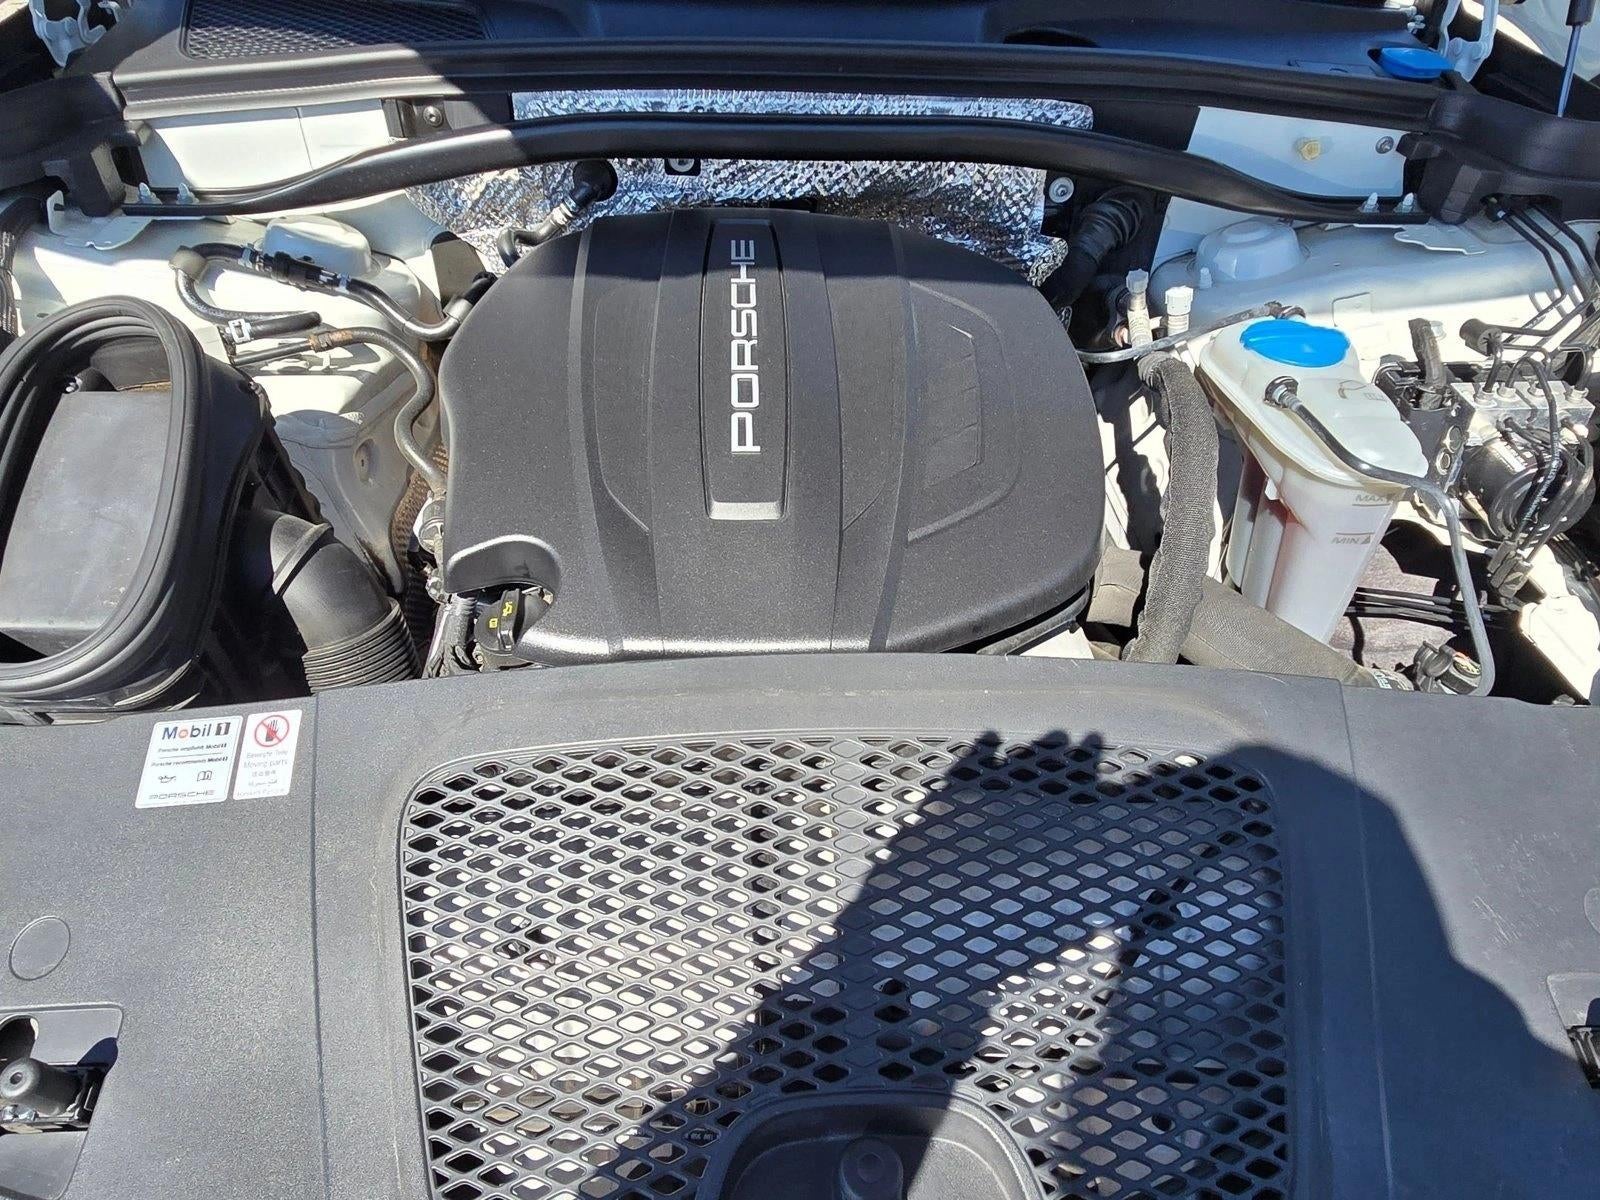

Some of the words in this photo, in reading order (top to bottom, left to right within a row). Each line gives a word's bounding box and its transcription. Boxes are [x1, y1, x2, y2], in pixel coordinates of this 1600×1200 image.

[730, 239, 761, 455] PORSCHE
[1355, 494, 1384, 502] MAX
[1331, 536, 1360, 544] MIN
[162, 723, 212, 740] Mobil
[215, 722, 232, 736] 1
[148, 790, 216, 800] PORSCHE
